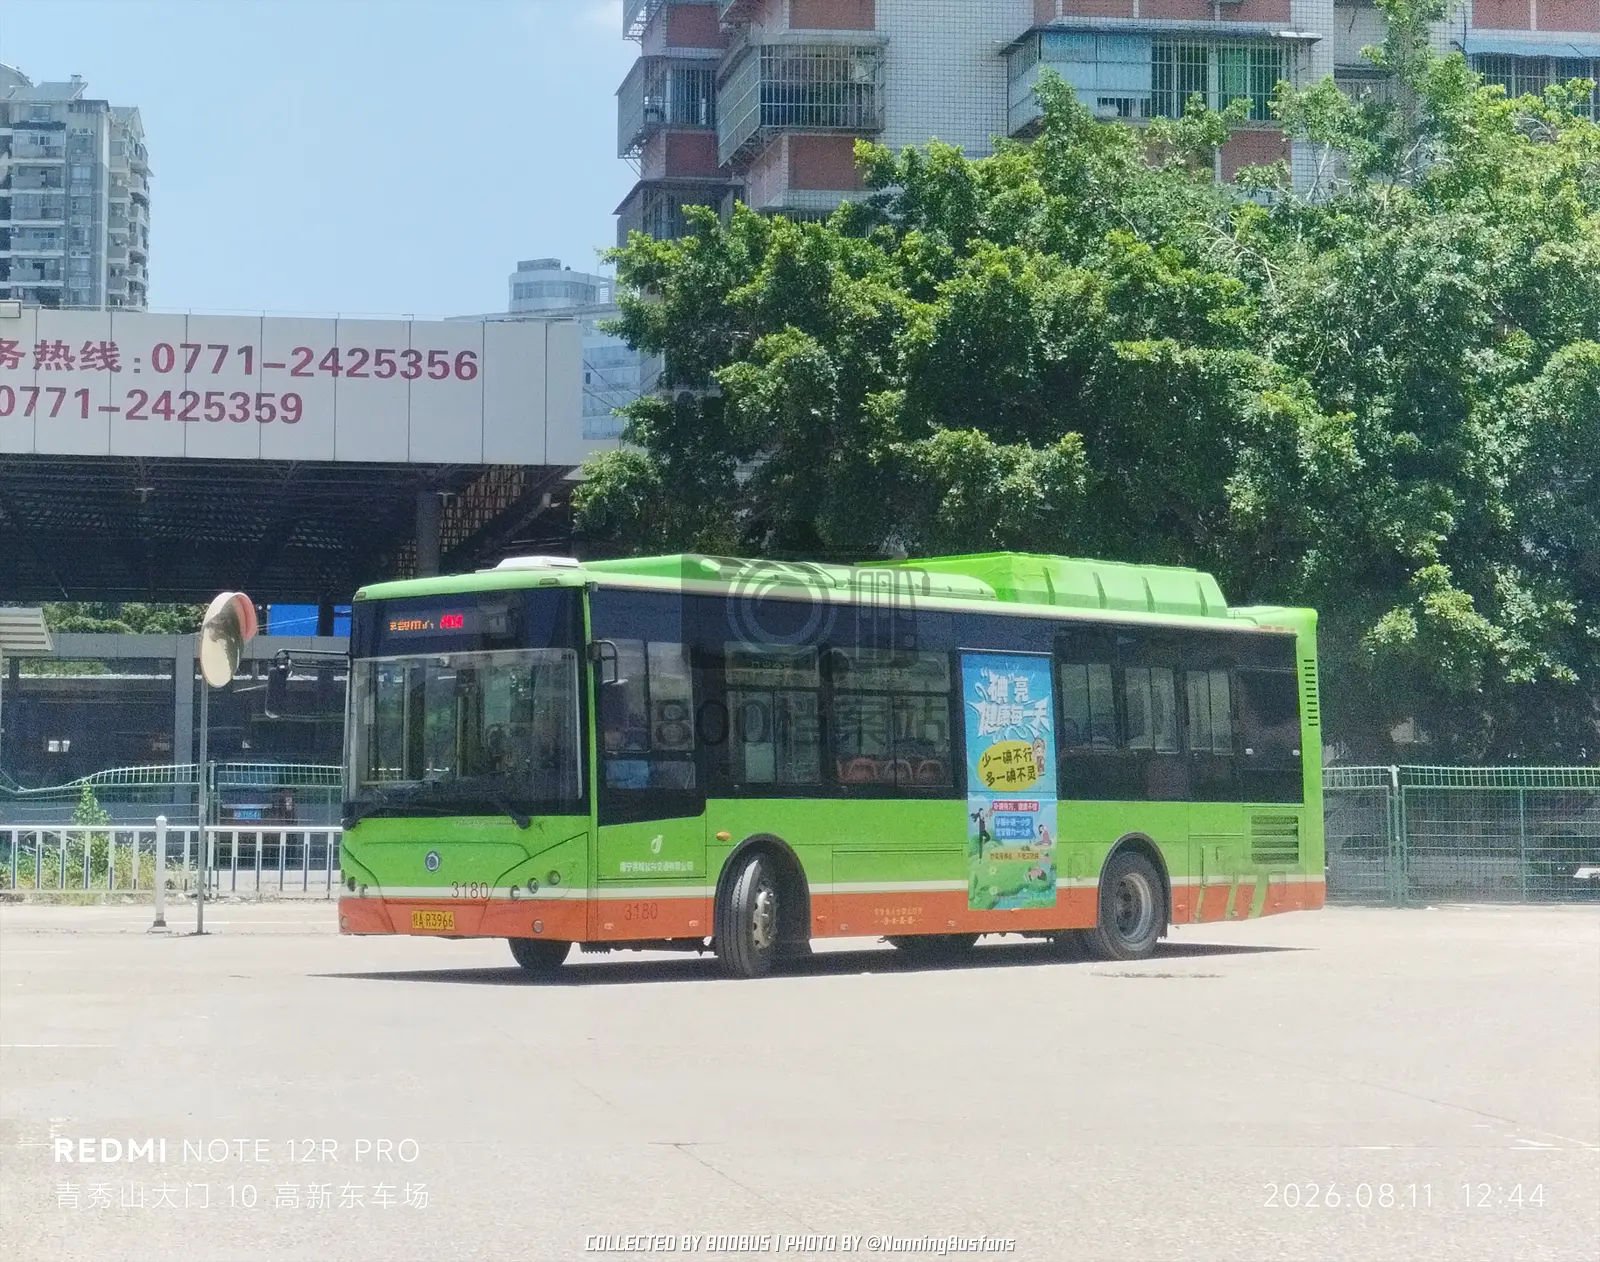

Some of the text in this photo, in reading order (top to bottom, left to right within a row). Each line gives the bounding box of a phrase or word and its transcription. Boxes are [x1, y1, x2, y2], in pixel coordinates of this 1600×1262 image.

[0, 385, 304, 425] 0771-2425359
[975, 697, 1050, 738] 健康每一天
[981, 747, 1033, 768] 少一碘不行
[985, 765, 1037, 787] 多一碘不灵
[451, 881, 489, 899] 3180
[624, 902, 659, 921] 3180
